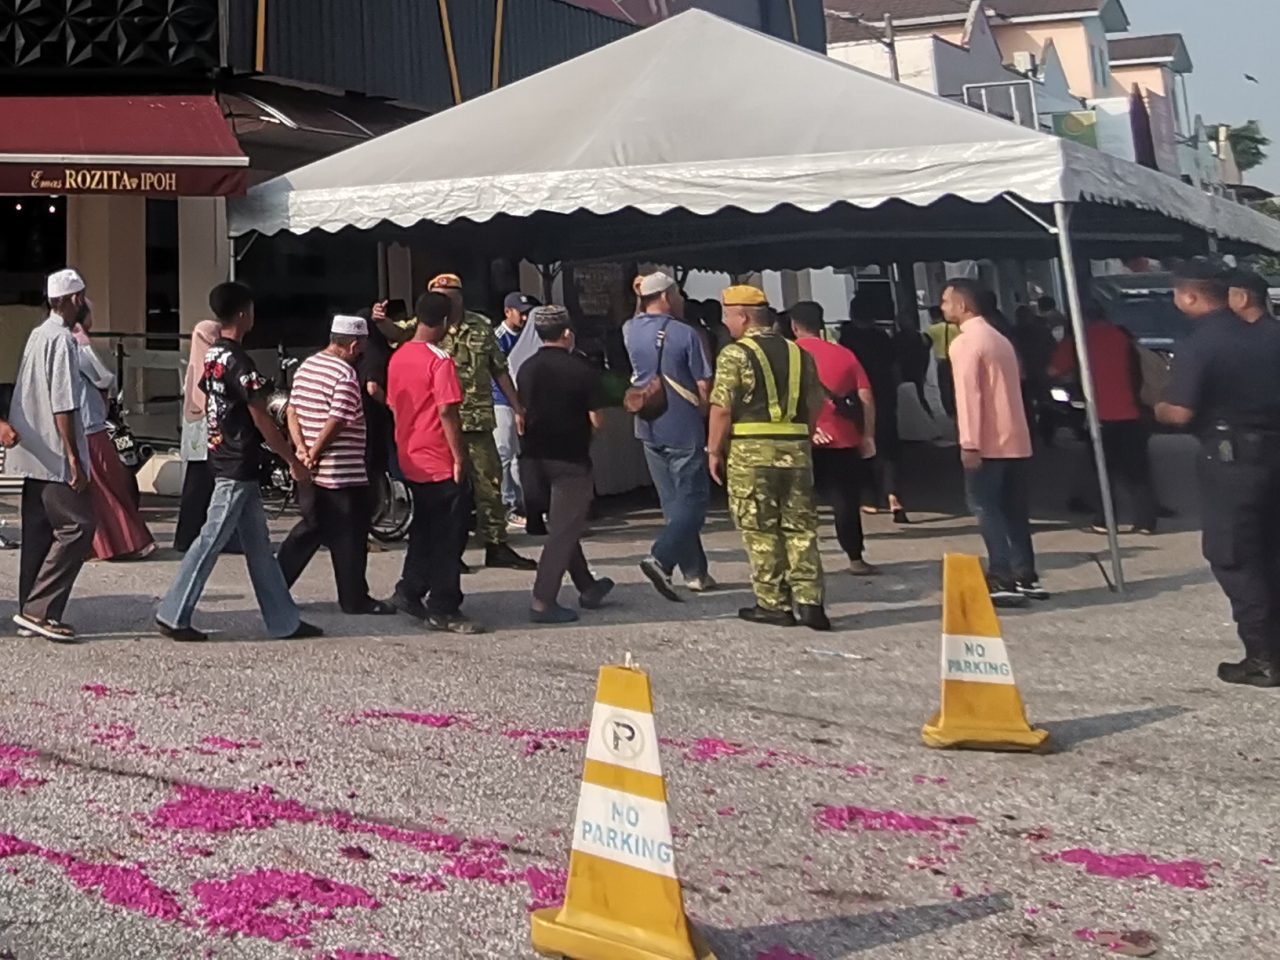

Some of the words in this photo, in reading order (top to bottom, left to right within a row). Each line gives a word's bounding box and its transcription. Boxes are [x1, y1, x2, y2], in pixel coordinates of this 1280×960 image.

[30, 170, 62, 189] Emas
[64, 169, 130, 190] ROZITA
[140, 172, 177, 191] IPOH
[964, 642, 985, 657] NO
[948, 659, 1010, 676] PARKING
[611, 802, 639, 827] NO
[582, 821, 671, 863] PARKING
